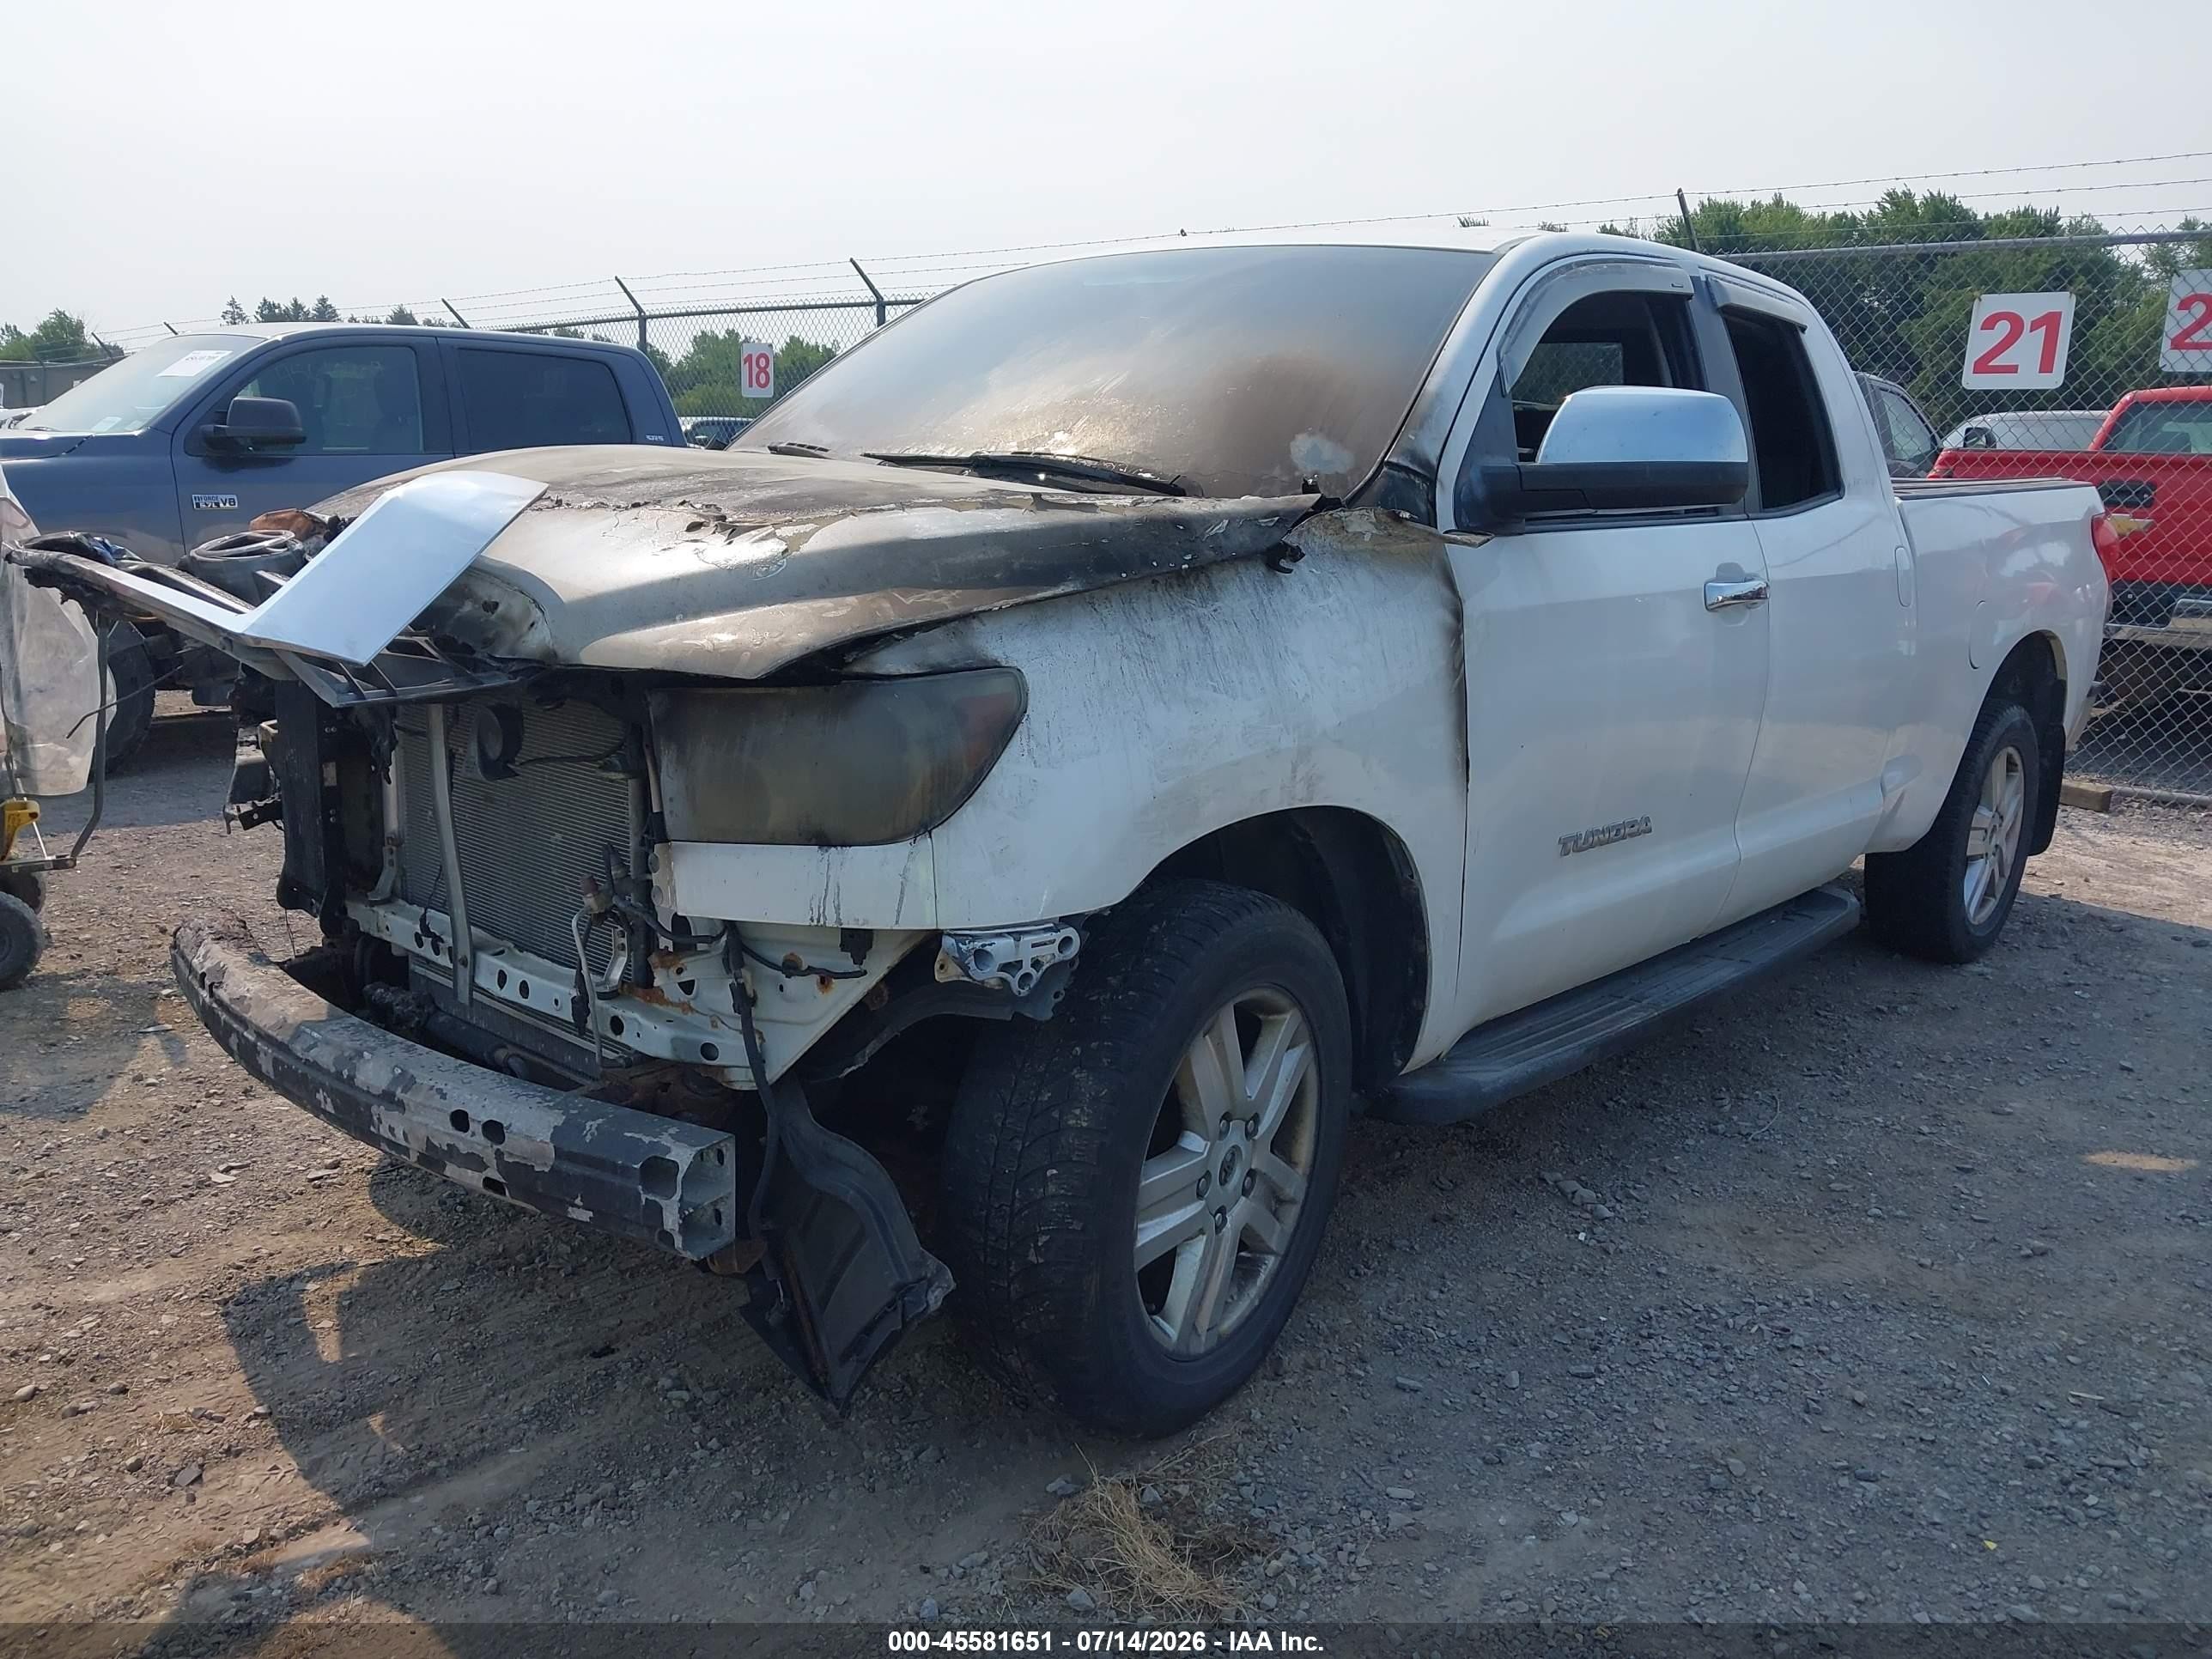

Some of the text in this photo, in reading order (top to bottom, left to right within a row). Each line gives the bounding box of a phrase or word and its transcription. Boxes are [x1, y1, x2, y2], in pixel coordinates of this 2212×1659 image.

[1972, 310, 2063, 374] 21
[743, 352, 770, 389] 18
[220, 497, 236, 507] V8
[1558, 814, 1653, 857] TUNDRA
